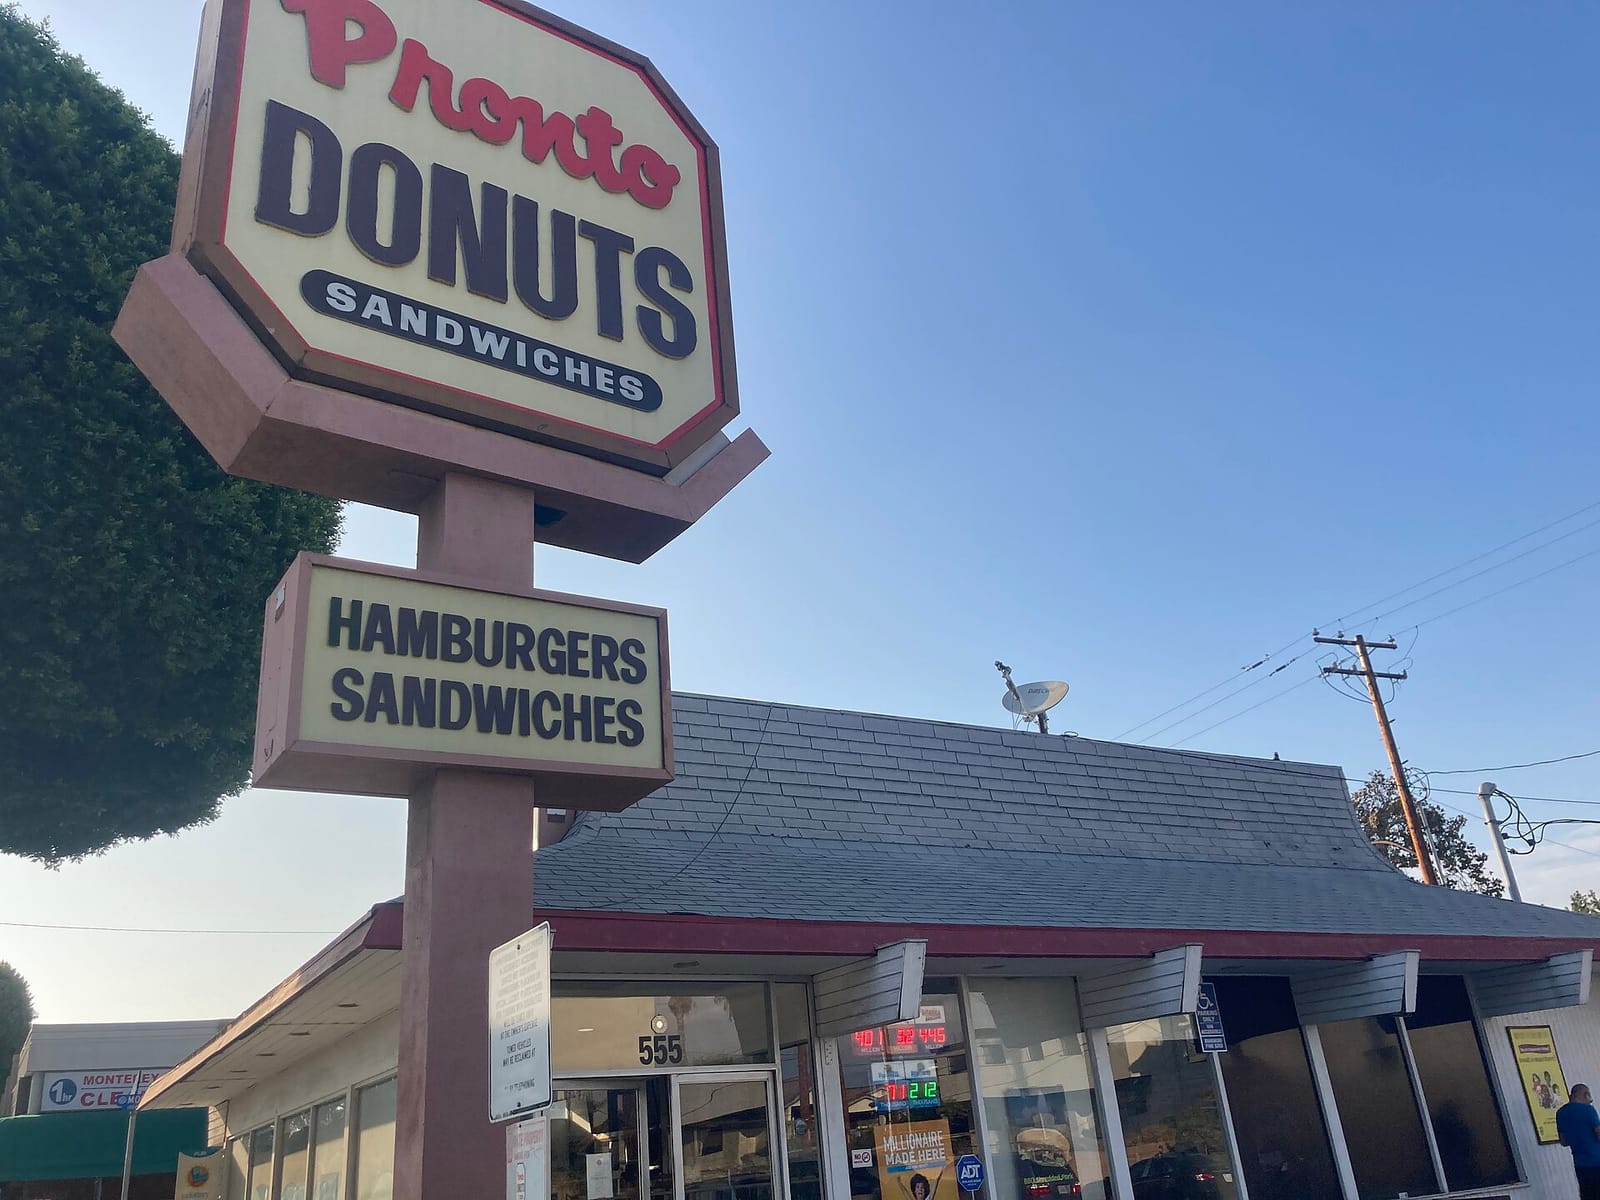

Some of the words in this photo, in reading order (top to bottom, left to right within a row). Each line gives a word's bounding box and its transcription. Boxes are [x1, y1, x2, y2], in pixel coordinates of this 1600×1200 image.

[280, 0, 682, 210] Pronto
[254, 98, 698, 361] DONUTS
[325, 280, 646, 403] SANDWICHES
[327, 595, 648, 685] HAMBURGERS
[330, 666, 646, 748] SANDWICHES
[638, 1034, 683, 1066] 555
[919, 1027, 946, 1044] 445
[910, 1081, 937, 1099] 212
[883, 1130, 945, 1152] MILLIONAIRE
[885, 1150, 916, 1165] MADE
[918, 1147, 946, 1161] HERE
[961, 1164, 981, 1179] ADT
